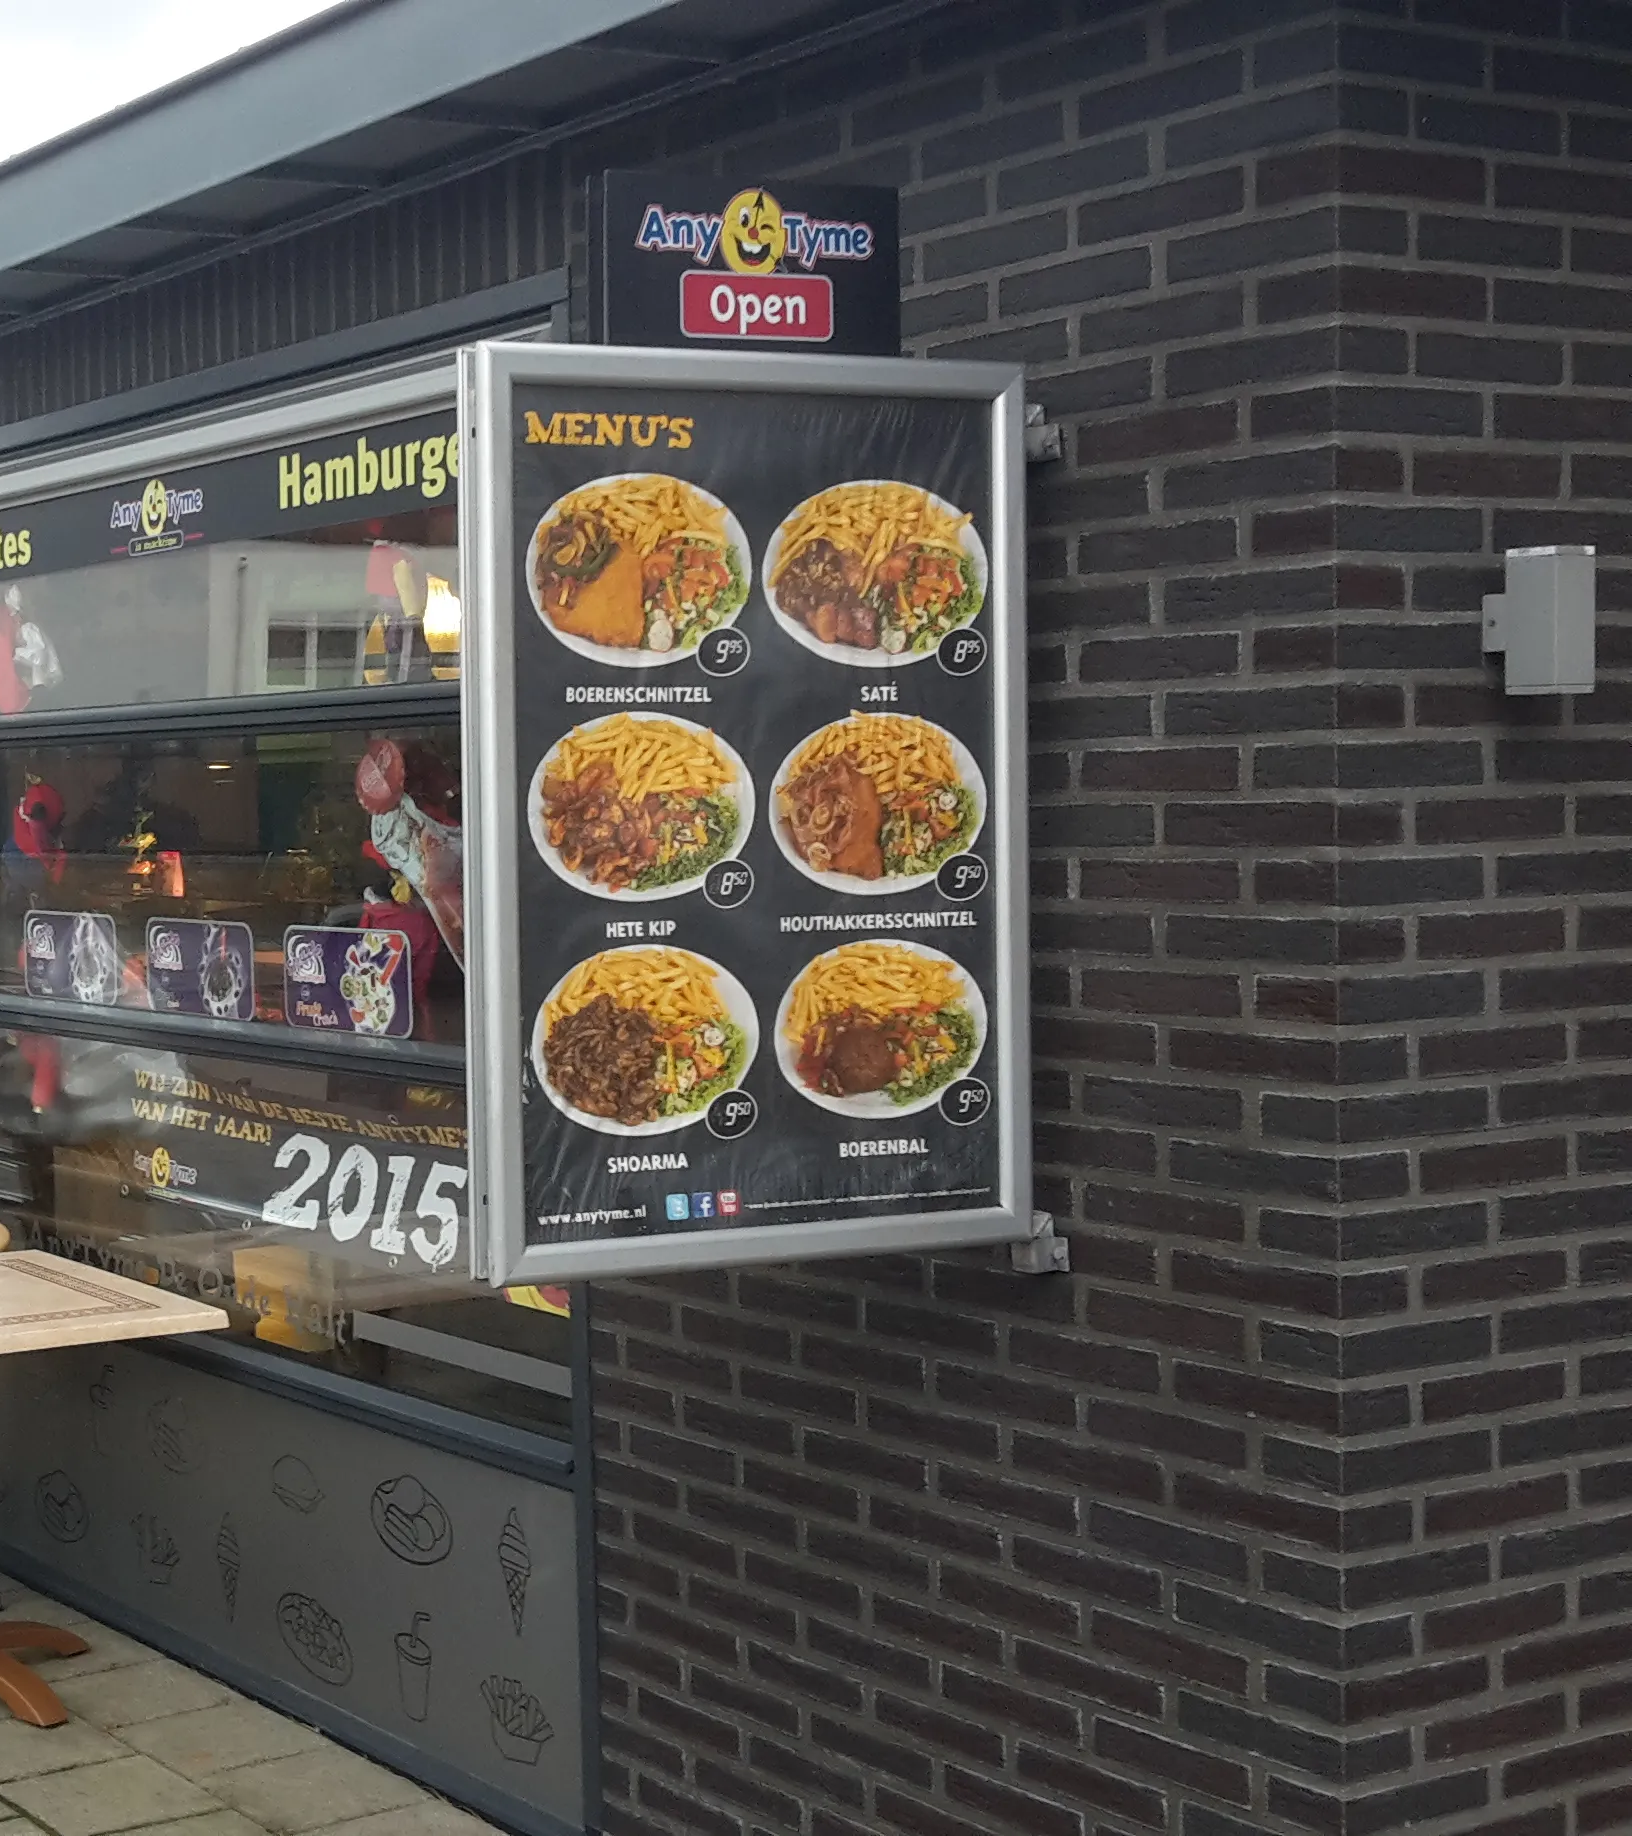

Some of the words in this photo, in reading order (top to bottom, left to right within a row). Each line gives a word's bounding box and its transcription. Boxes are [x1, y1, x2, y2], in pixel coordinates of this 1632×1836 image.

[638, 206, 719, 264] Any
[784, 213, 873, 268] Tyme
[710, 284, 807, 335] Open
[525, 410, 695, 449] MENU'S
[110, 500, 142, 533] Any
[166, 488, 203, 525] Tyme
[566, 686, 712, 704] BOERENSCHNITZEL
[860, 681, 899, 702] SATÉ
[606, 922, 645, 939] HETE
[648, 919, 676, 937] KIP
[780, 911, 977, 933] HOUTHAKKERSSCHNITZEL
[135, 1069, 166, 1093] WIJ
[172, 1076, 211, 1102] ZIJN
[259, 1100, 289, 1121] DE
[287, 1106, 354, 1133] BESTE
[131, 1097, 167, 1123] VAN
[170, 1105, 212, 1131] HET
[214, 1115, 273, 1147] JAAR!
[839, 1138, 929, 1158] BOERENBAL
[607, 1153, 688, 1174] SHOARMA
[262, 1132, 467, 1271] 2015
[537, 1204, 647, 1226] www.anytyme.nl
